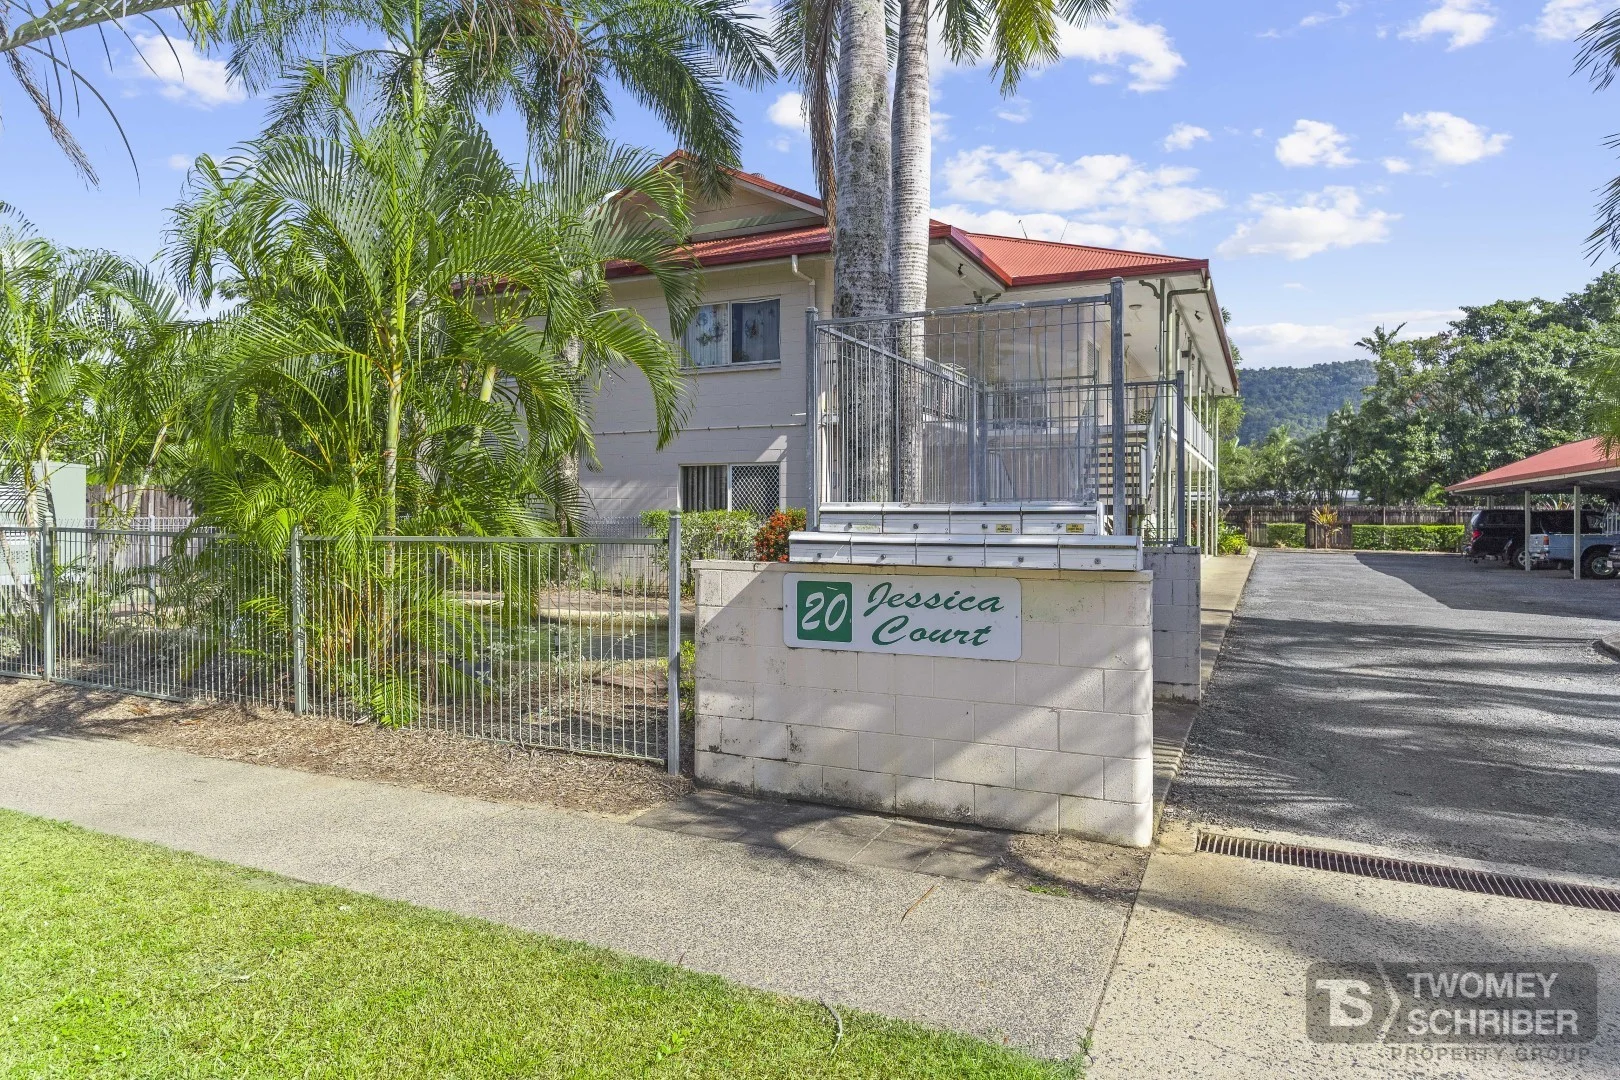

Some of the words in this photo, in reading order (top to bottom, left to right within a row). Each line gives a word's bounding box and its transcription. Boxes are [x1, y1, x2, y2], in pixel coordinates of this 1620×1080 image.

[801, 592, 848, 631] 20
[863, 582, 1004, 617] Jessica
[871, 615, 992, 646] Court
